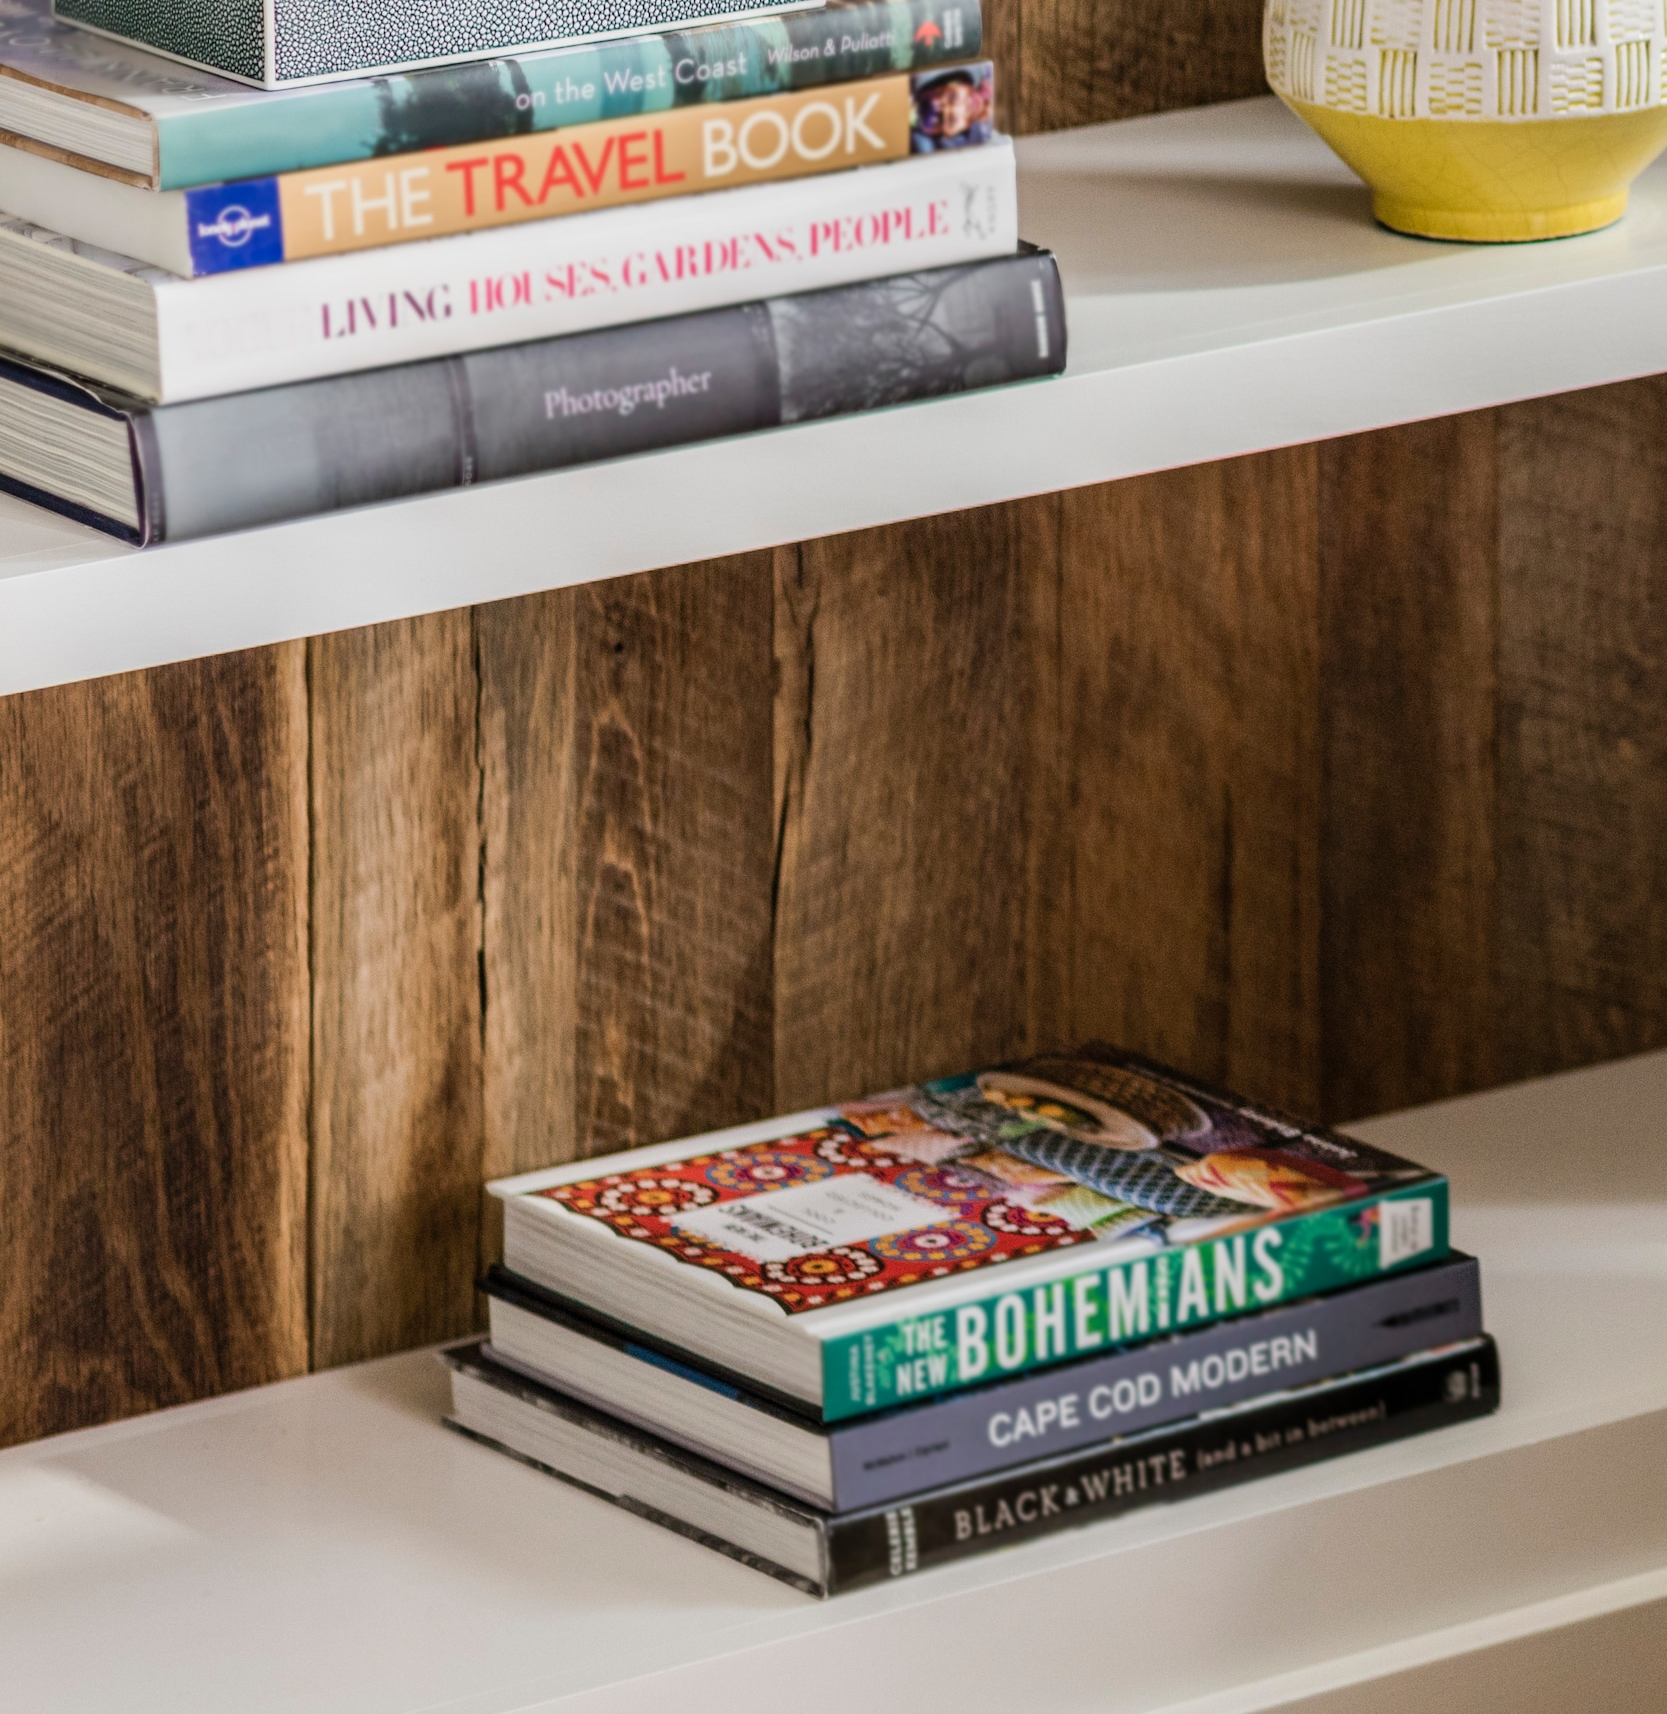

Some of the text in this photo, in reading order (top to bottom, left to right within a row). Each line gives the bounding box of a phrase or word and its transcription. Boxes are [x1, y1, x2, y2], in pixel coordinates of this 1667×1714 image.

[515, 51, 748, 111] on the West Coast
[767, 43, 819, 66] Wilson
[823, 37, 837, 57] &
[303, 93, 887, 242] THE TRAVEL BOOK
[320, 284, 453, 340] LIVING
[469, 257, 619, 315] HOUSES,
[621, 228, 803, 289] GARDENS,
[808, 200, 950, 258] PEOPLE
[543, 366, 713, 420] Photographer
[903, 1315, 949, 1356] THE
[955, 1227, 1285, 1383] BOHEMIANS
[896, 1353, 948, 1397] NEW
[987, 1328, 1319, 1448] CAPE COD MODERN
[954, 1483, 1062, 1540] BLACK
[1064, 1485, 1079, 1506] &
[1079, 1449, 1187, 1502] WHITE
[1254, 1431, 1281, 1453] bit
